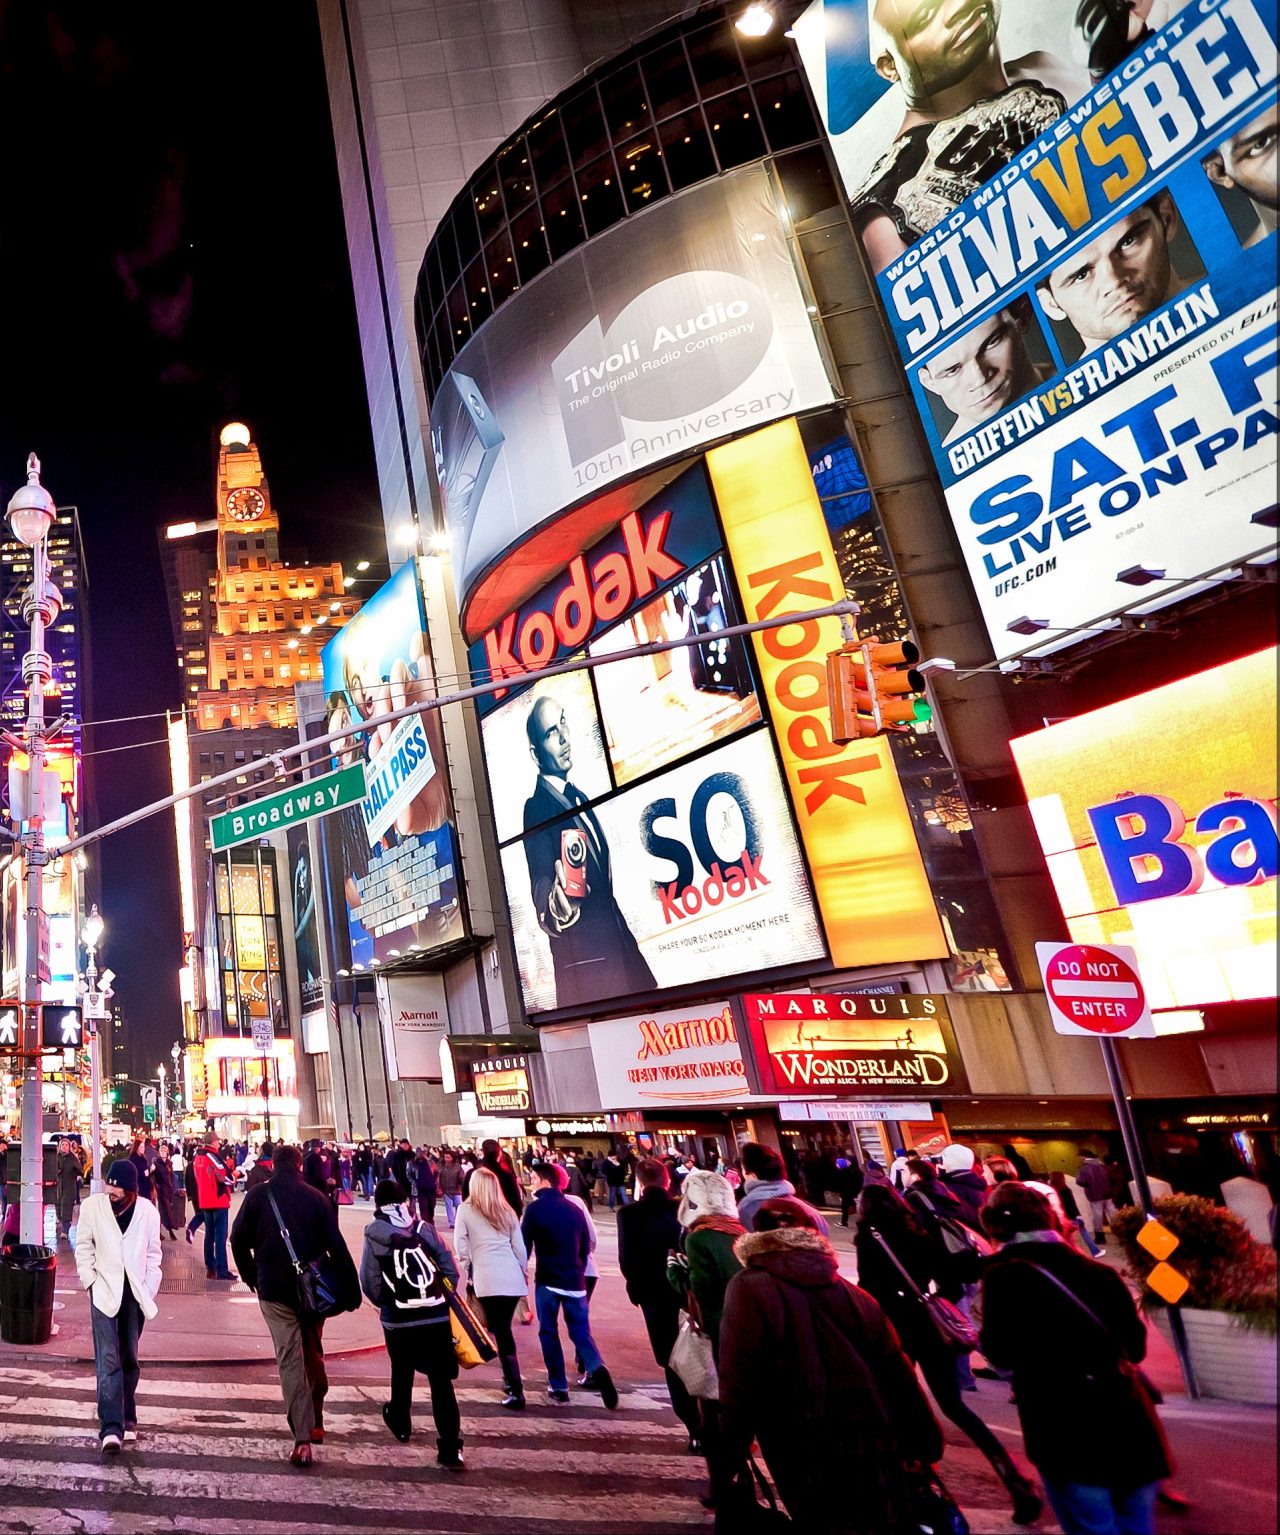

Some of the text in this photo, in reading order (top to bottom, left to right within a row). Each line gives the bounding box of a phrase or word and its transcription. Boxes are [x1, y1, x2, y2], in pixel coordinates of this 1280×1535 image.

[885, 16, 1187, 282] WORLD MIDDLEWEIGHT
[890, 176, 1068, 354] SILVA
[1031, 98, 1147, 232] VS
[564, 298, 750, 395] Tivoli Audio
[568, 320, 756, 412] The Original Radio Company
[1152, 338, 1218, 382] PRESENTED
[1220, 327, 1235, 342] BY
[948, 283, 1221, 476] GRIFFIN VS FRANKLIN
[573, 388, 796, 488] 10th Anniversary
[969, 385, 1202, 546] SAT.
[982, 503, 1093, 579] LIVE
[1099, 455, 1188, 518] ON
[483, 510, 687, 701] Kodak
[994, 556, 1058, 598] UFC.COM
[23, 688, 61, 698] THIBA
[747, 551, 885, 817] Kodak
[363, 769, 394, 825] HALL
[390, 725, 427, 790] PASS
[232, 783, 340, 836] Broadway
[640, 771, 763, 901] SO
[658, 850, 772, 925] Kodak
[680, 936, 698, 947] YOUR
[708, 927, 734, 941] KODAK
[767, 913, 790, 927] HERE
[1057, 961, 1119, 978] DO NOT
[399, 1011, 438, 1022] Marriott
[757, 998, 936, 1016] MARQUIS
[1071, 1001, 1127, 1018] ENTER
[473, 1056, 526, 1073] MARQUIS
[627, 1067, 658, 1083] NEW
[658, 1063, 700, 1081] YORK
[774, 1053, 949, 1085] WONDERLAND
[477, 1090, 530, 1112] WONDERLAND
